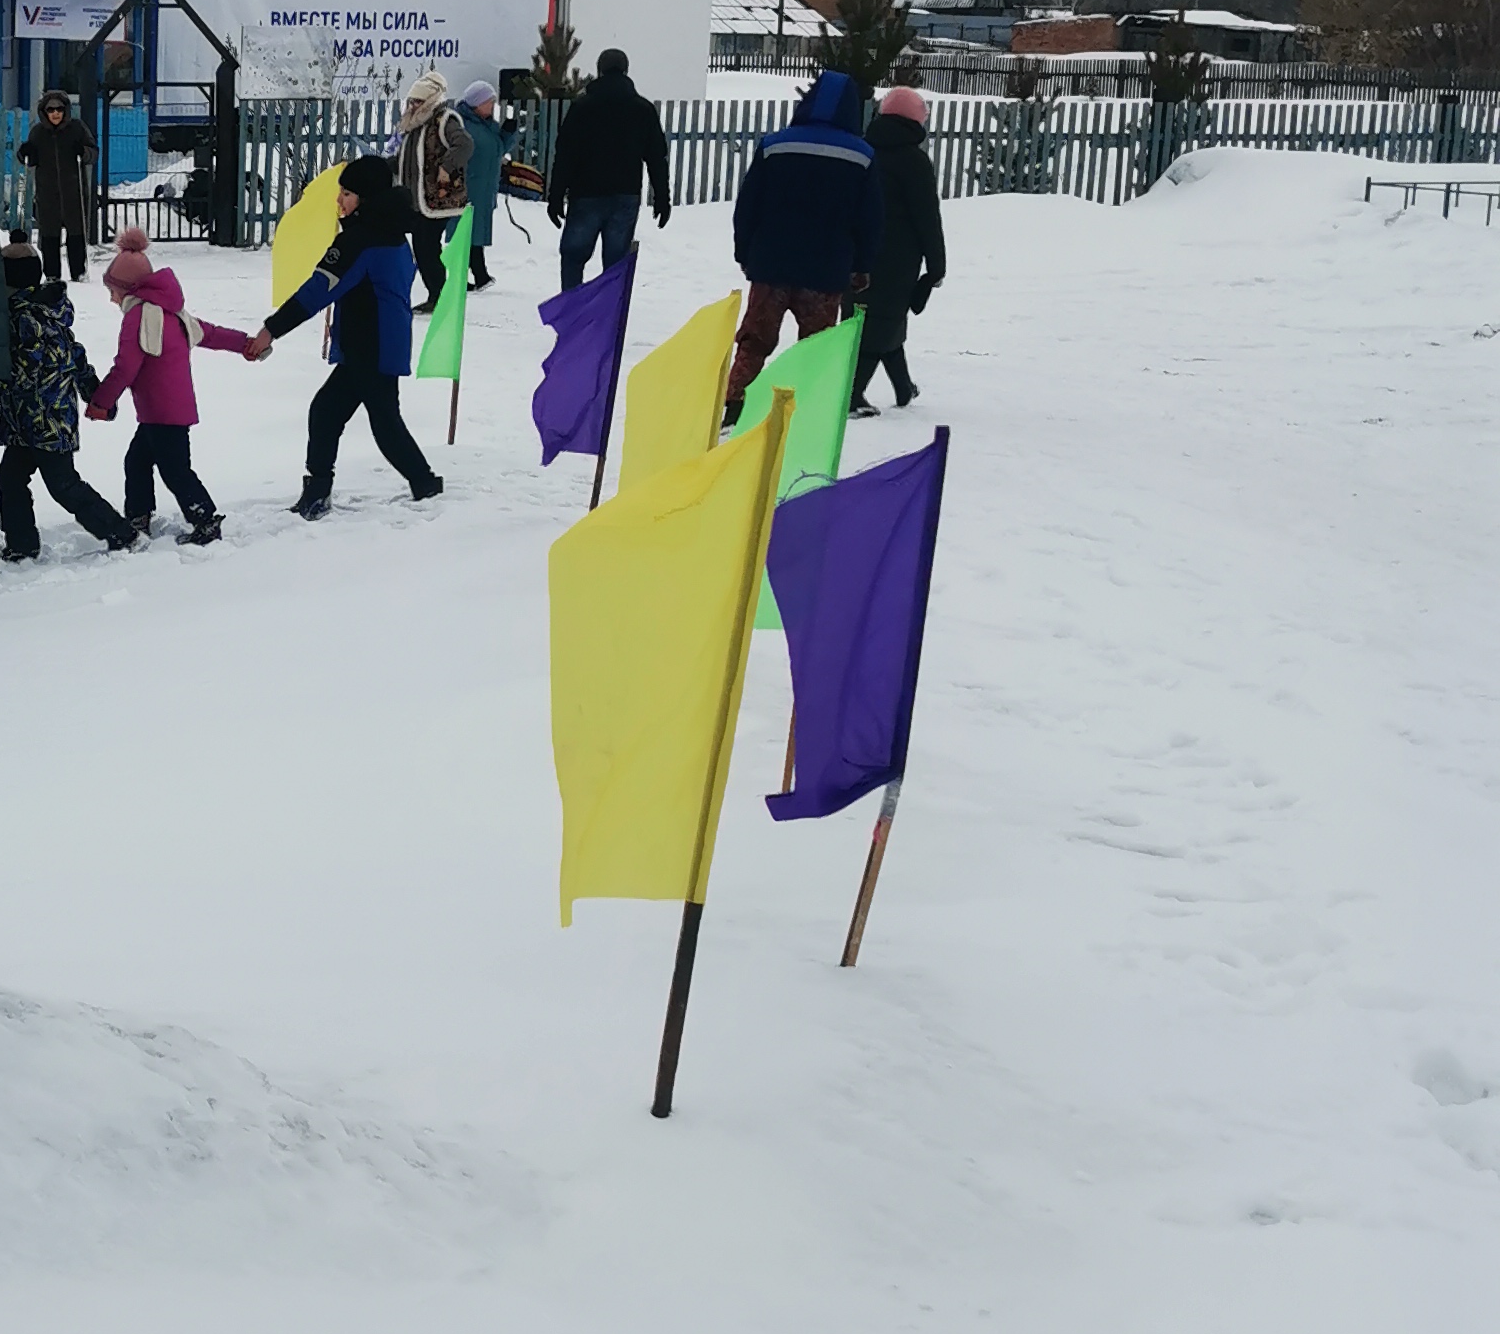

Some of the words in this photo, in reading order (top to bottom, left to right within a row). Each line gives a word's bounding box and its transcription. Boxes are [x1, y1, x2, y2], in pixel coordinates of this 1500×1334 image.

[270, 11, 340, 30] ВМЕСТЕ
[346, 11, 377, 30] МЫ
[382, 11, 429, 31] СИЛА
[353, 39, 374, 58] ЗА
[380, 39, 459, 58] РОССИЮ!
